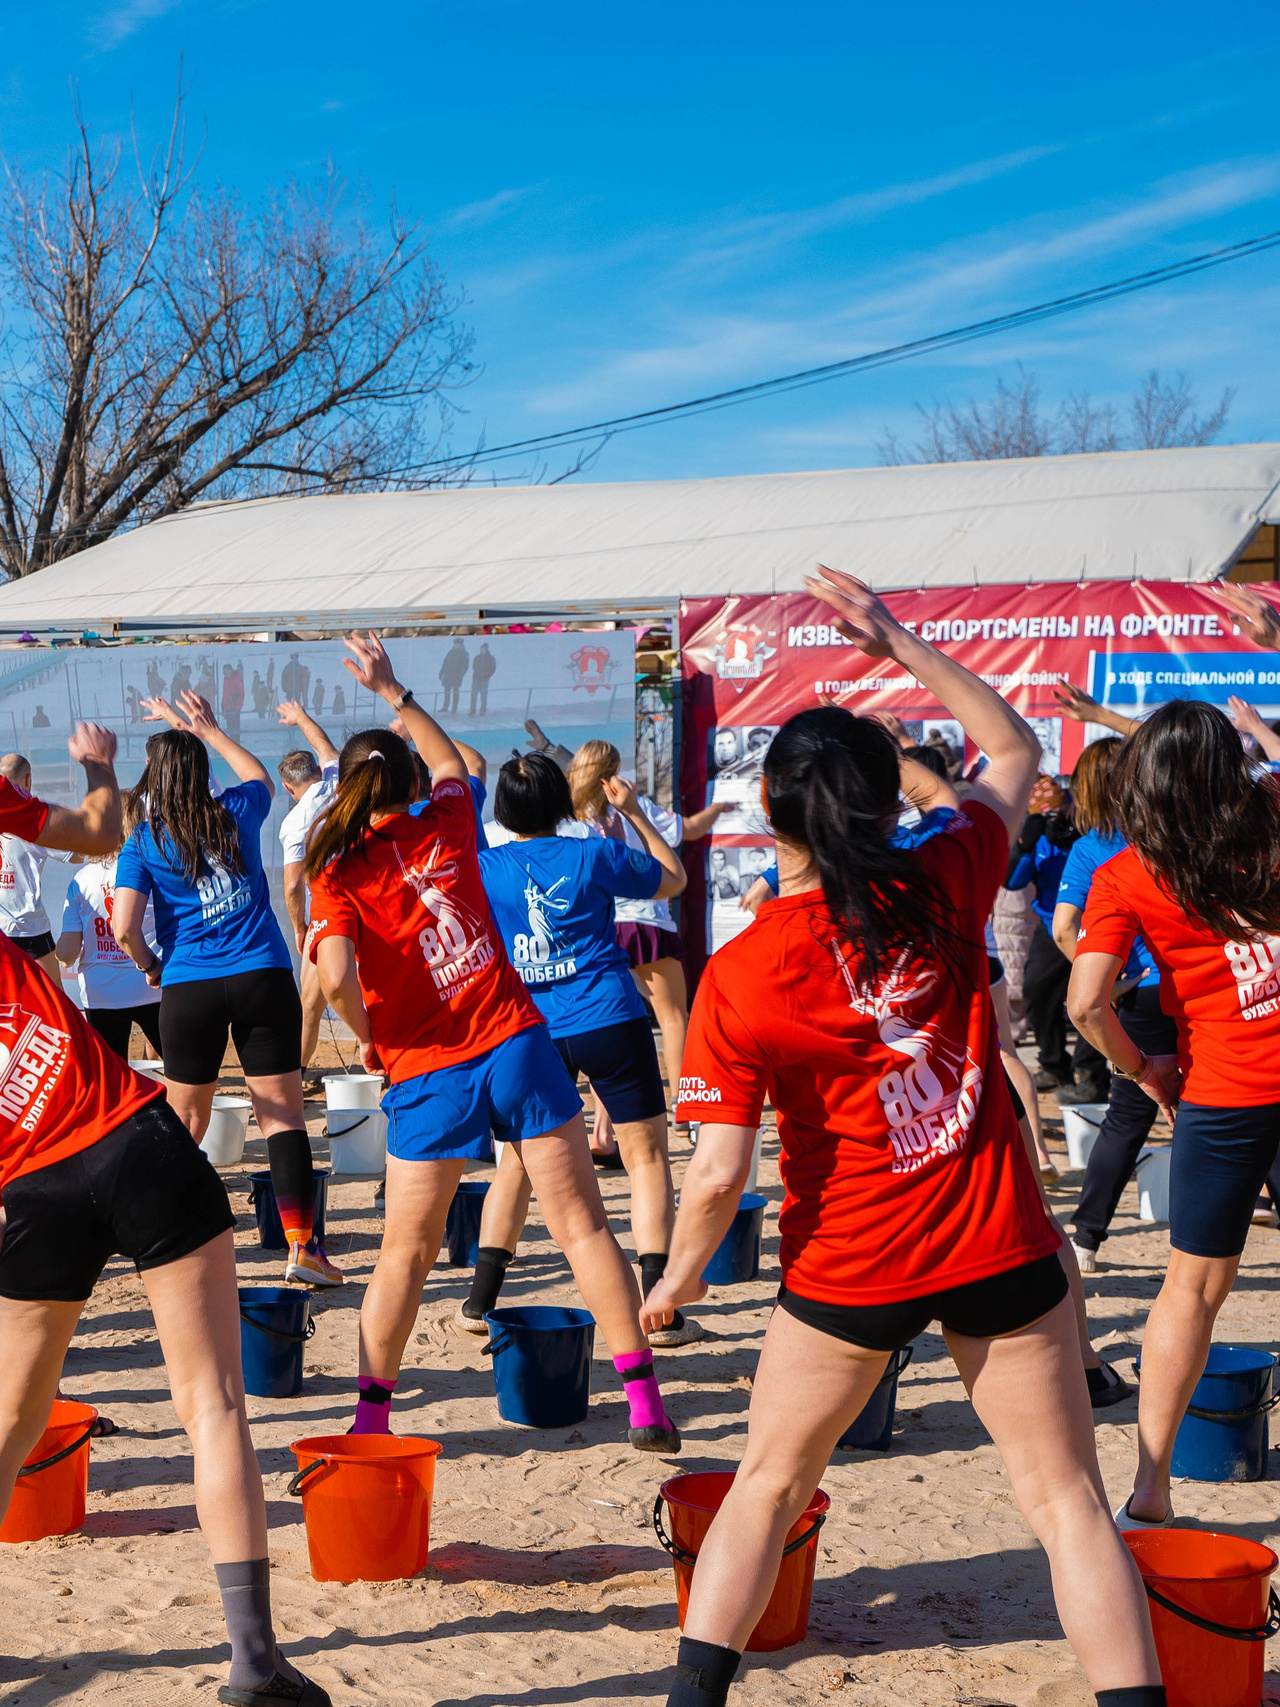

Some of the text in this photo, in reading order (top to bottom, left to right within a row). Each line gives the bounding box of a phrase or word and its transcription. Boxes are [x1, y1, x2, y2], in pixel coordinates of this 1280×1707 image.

[921, 615, 1078, 642] СПОРТСМЕНЫ
[1084, 615, 1115, 637] НА
[1120, 613, 1224, 637] ФРОНТЕ.
[815, 680, 824, 694] В
[1119, 671, 1153, 686] ХОДЕ
[1156, 669, 1255, 687] СПЕЦИАЛЬНОЙ
[196, 866, 233, 904] 80
[419, 917, 467, 966] 80
[513, 933, 550, 964] 80
[431, 941, 494, 990] ПОБЕДА
[514, 961, 578, 983] ПОБЕДА
[1241, 999, 1278, 1021] БУДЕТ
[677, 1087, 722, 1103] ДОМОЙ
[679, 1077, 707, 1090] ПУТЬ
[877, 1062, 944, 1129] 80
